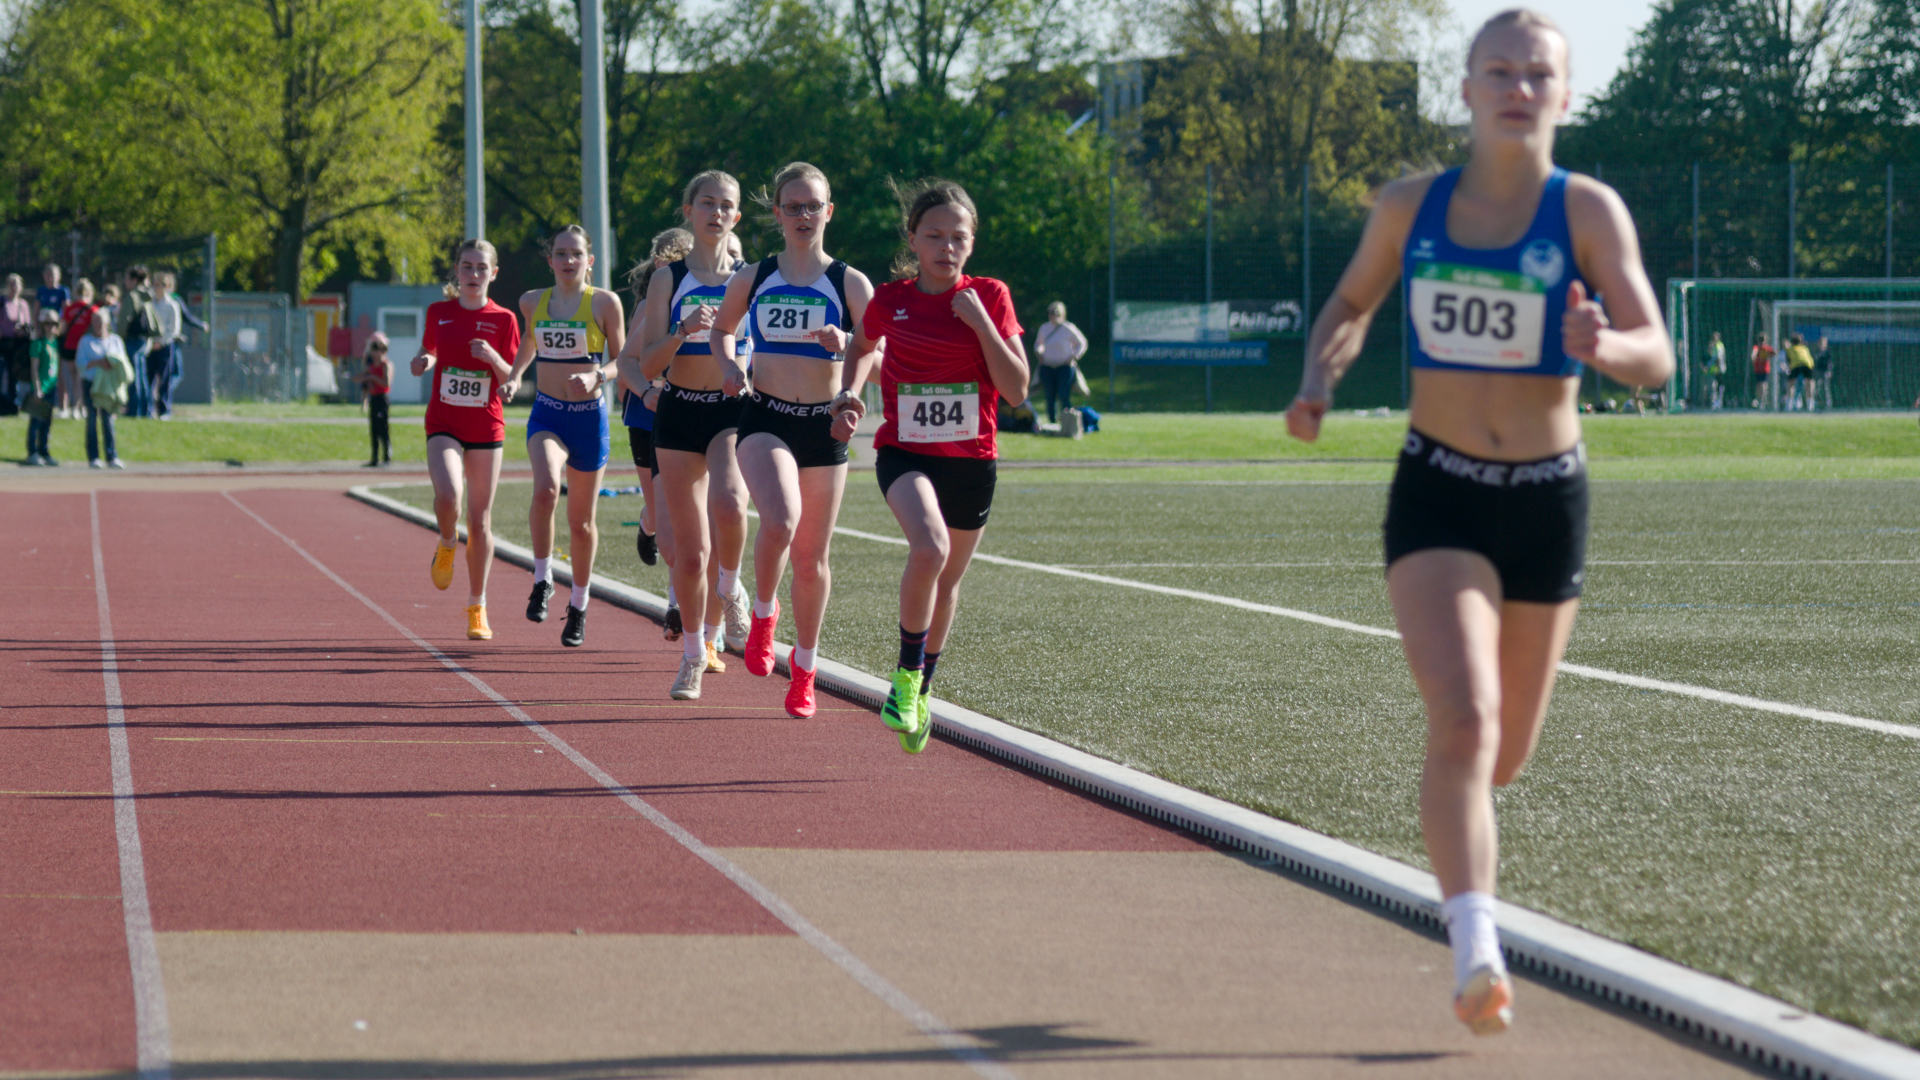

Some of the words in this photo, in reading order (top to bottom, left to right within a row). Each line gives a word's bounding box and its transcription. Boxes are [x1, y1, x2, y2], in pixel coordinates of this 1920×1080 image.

[767, 308, 810, 330] 281
[1229, 311, 1289, 332] Philipp
[1431, 292, 1516, 341] 503
[543, 332, 576, 349] 525
[448, 378, 481, 397] 389
[675, 389, 720, 403] NIKE
[921, 386, 934, 394] SuS
[934, 386, 952, 394] Olfen
[536, 395, 564, 411] PRO
[567, 401, 600, 413] NIKE
[767, 399, 812, 417] NIKE
[811, 404, 832, 417] PR
[912, 400, 964, 427] 484
[1428, 446, 1509, 487] NIKE
[1510, 453, 1577, 487] PRO
